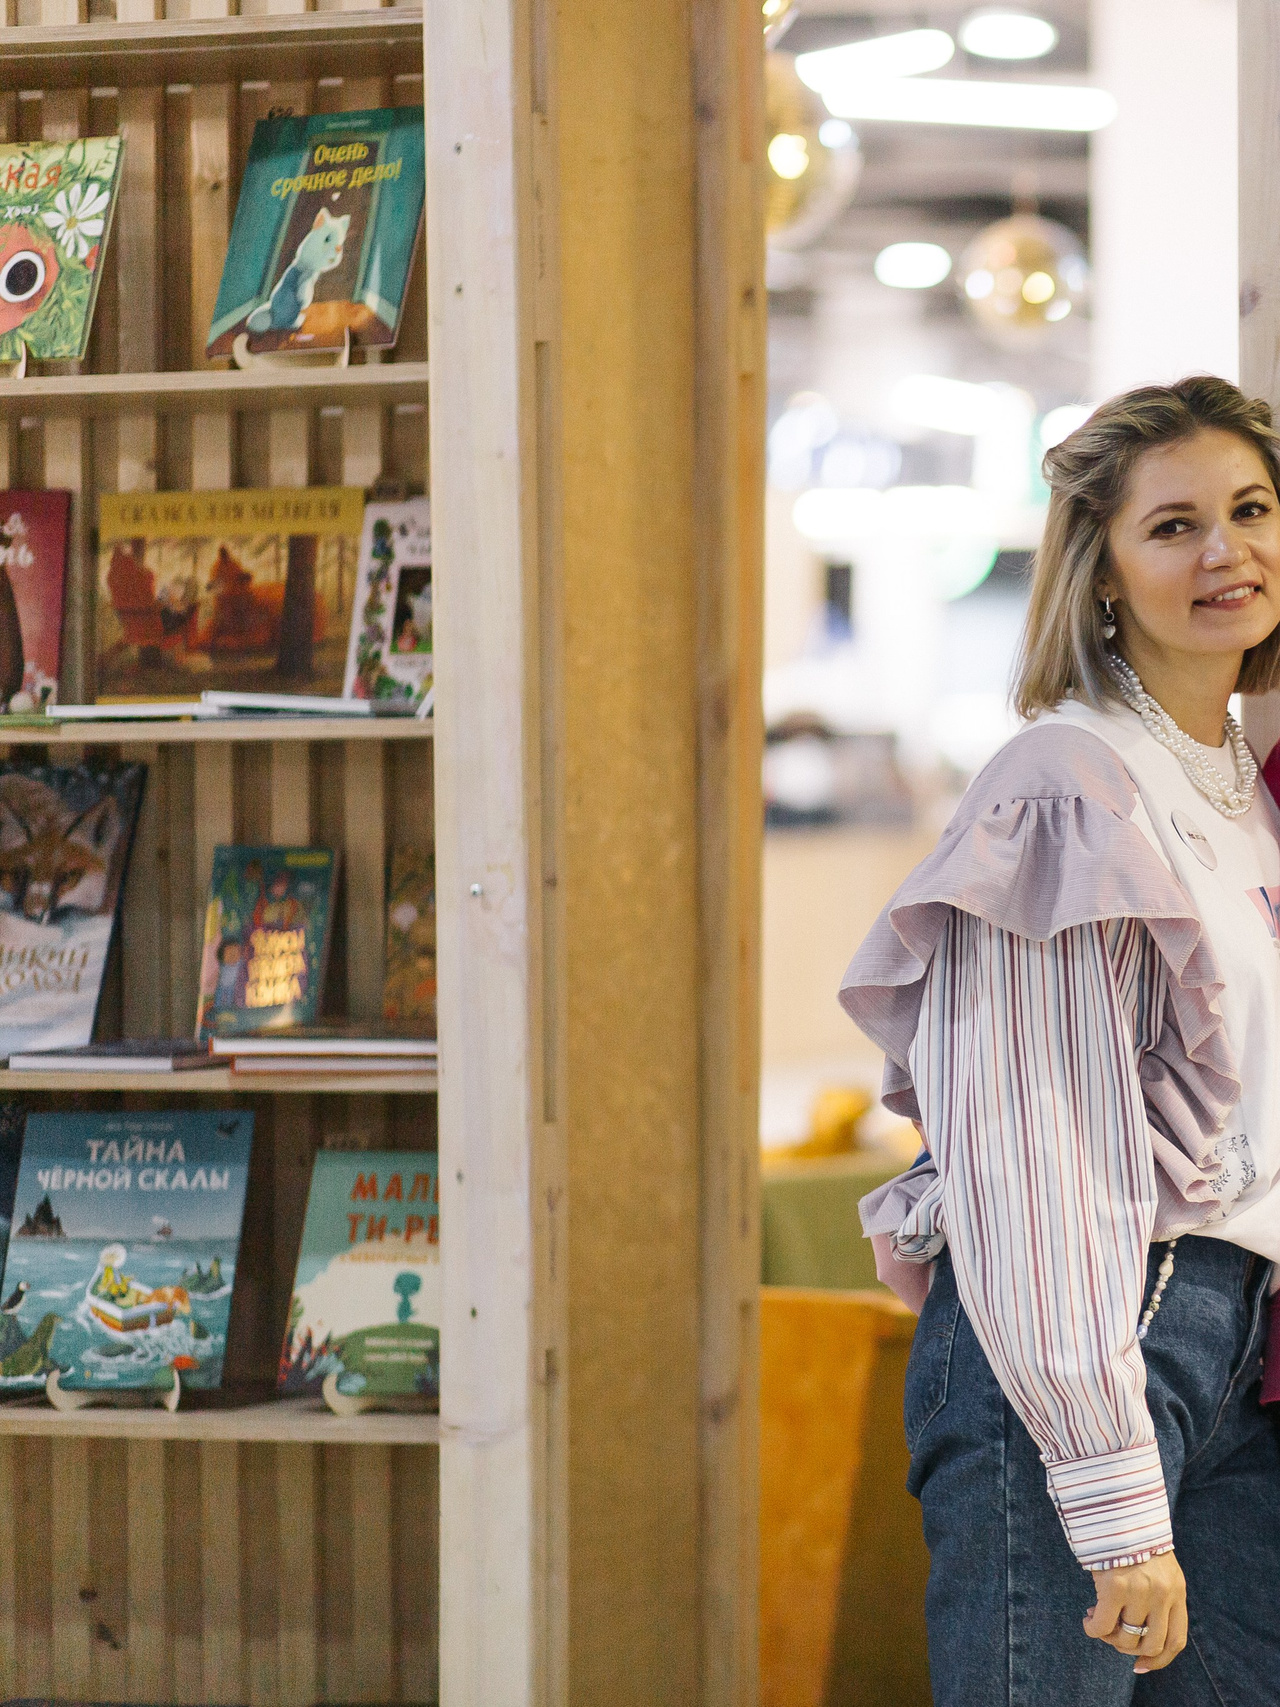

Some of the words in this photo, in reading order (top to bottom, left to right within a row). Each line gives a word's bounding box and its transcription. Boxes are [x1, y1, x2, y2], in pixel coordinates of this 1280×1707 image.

[314, 141, 370, 166] Очень
[271, 171, 347, 202] срочное
[348, 158, 404, 190] дело!
[86, 1136, 186, 1165] ТАЙНА
[37, 1165, 132, 1191] ЧЁРНОЙ
[138, 1167, 230, 1191] СКАЛЫ
[350, 1172, 438, 1202] МАЛ
